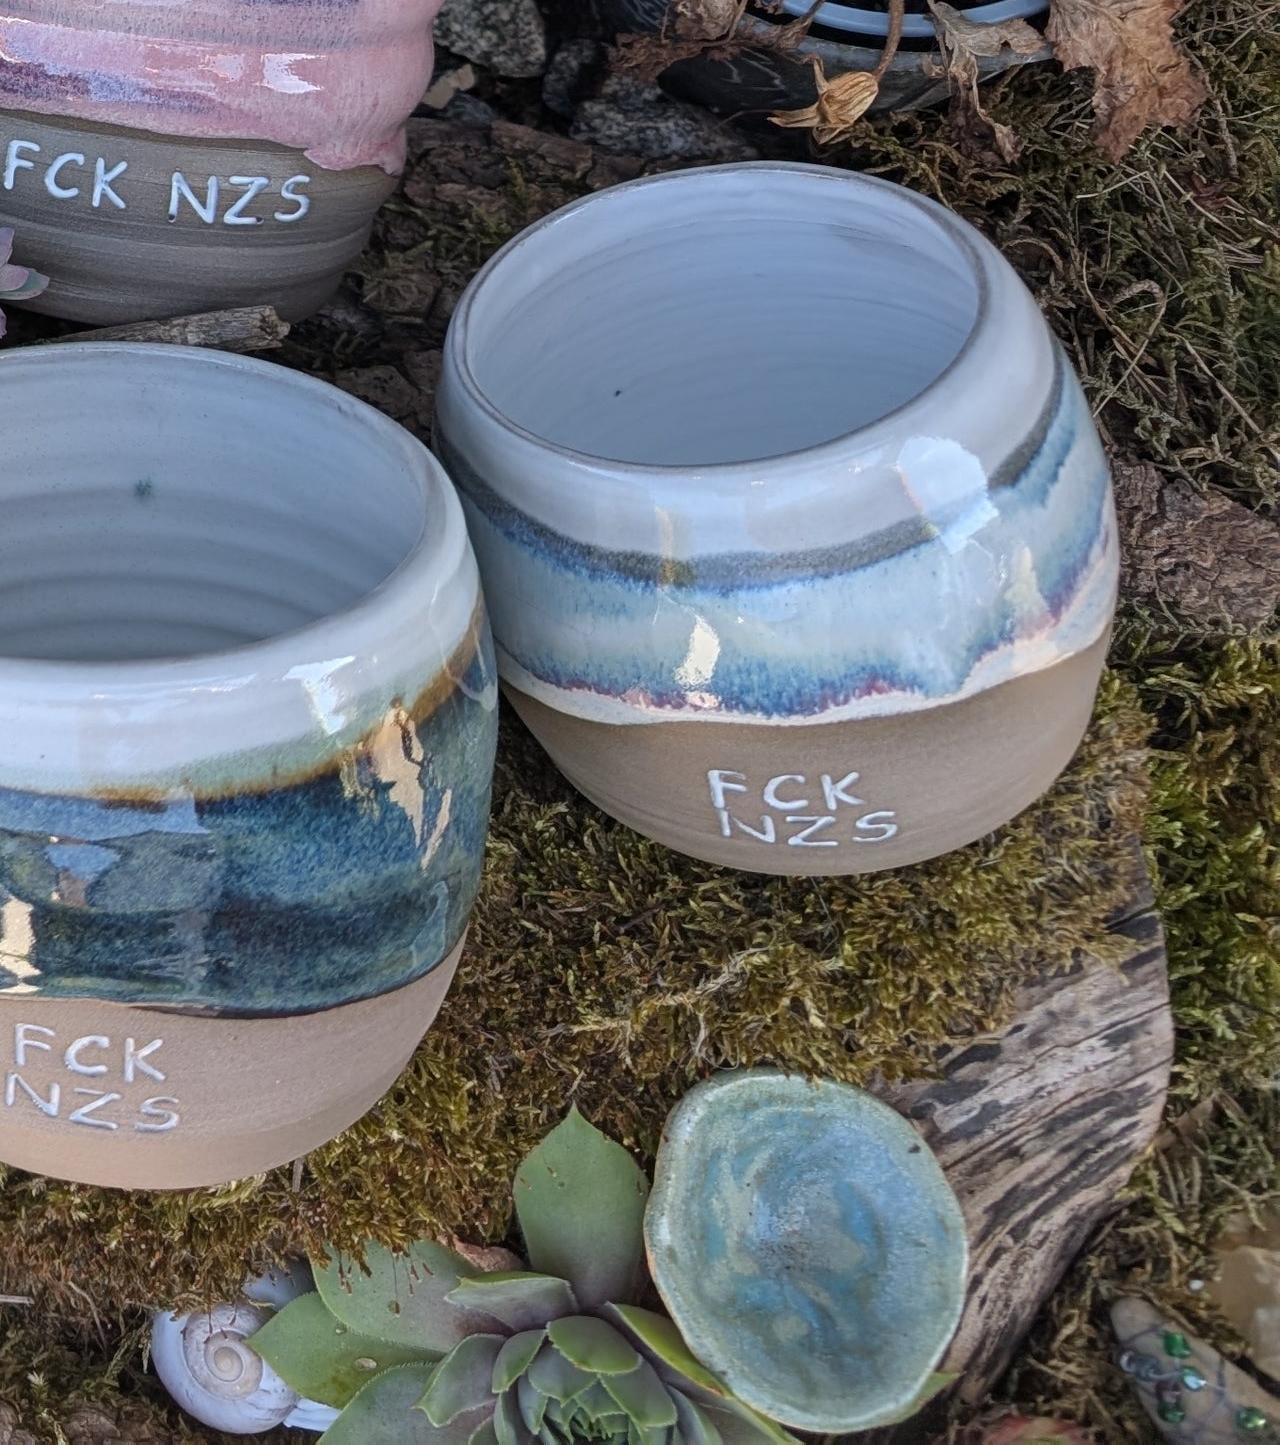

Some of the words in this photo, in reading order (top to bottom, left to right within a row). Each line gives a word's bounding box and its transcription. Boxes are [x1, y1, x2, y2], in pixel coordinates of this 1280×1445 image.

[3, 137, 127, 211] FCK
[168, 171, 310, 226] NZS
[708, 769, 863, 811] FCK
[719, 810, 900, 848] NZS
[14, 1021, 165, 1083] FCK
[4, 1072, 181, 1131] NZS
